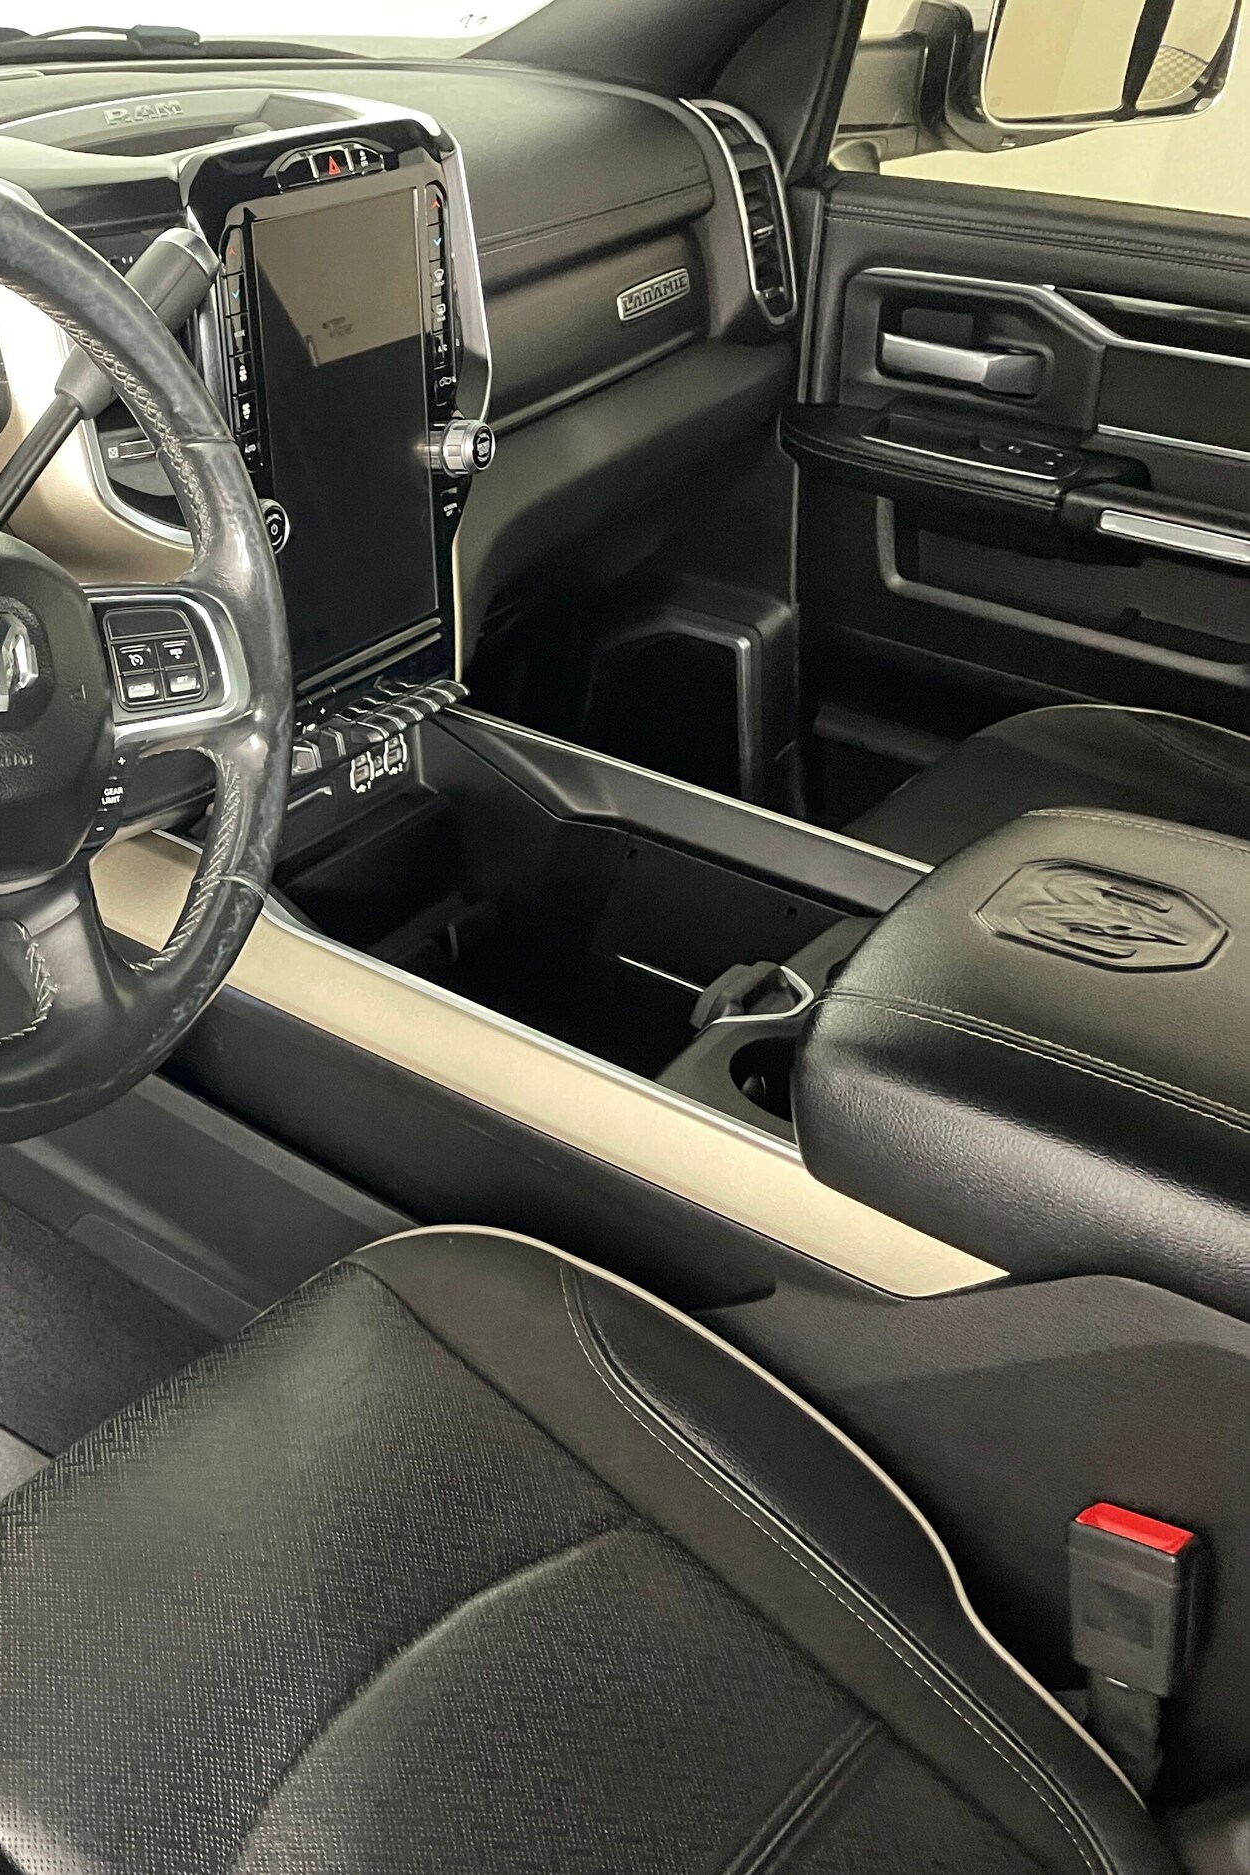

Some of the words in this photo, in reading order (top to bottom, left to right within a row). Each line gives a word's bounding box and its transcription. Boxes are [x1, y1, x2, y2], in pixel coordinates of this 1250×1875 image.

[103, 100, 183, 125] RAM
[622, 275, 687, 312] LARAMIE
[103, 786, 124, 796] GEAR
[101, 795, 121, 805] LIMIT
